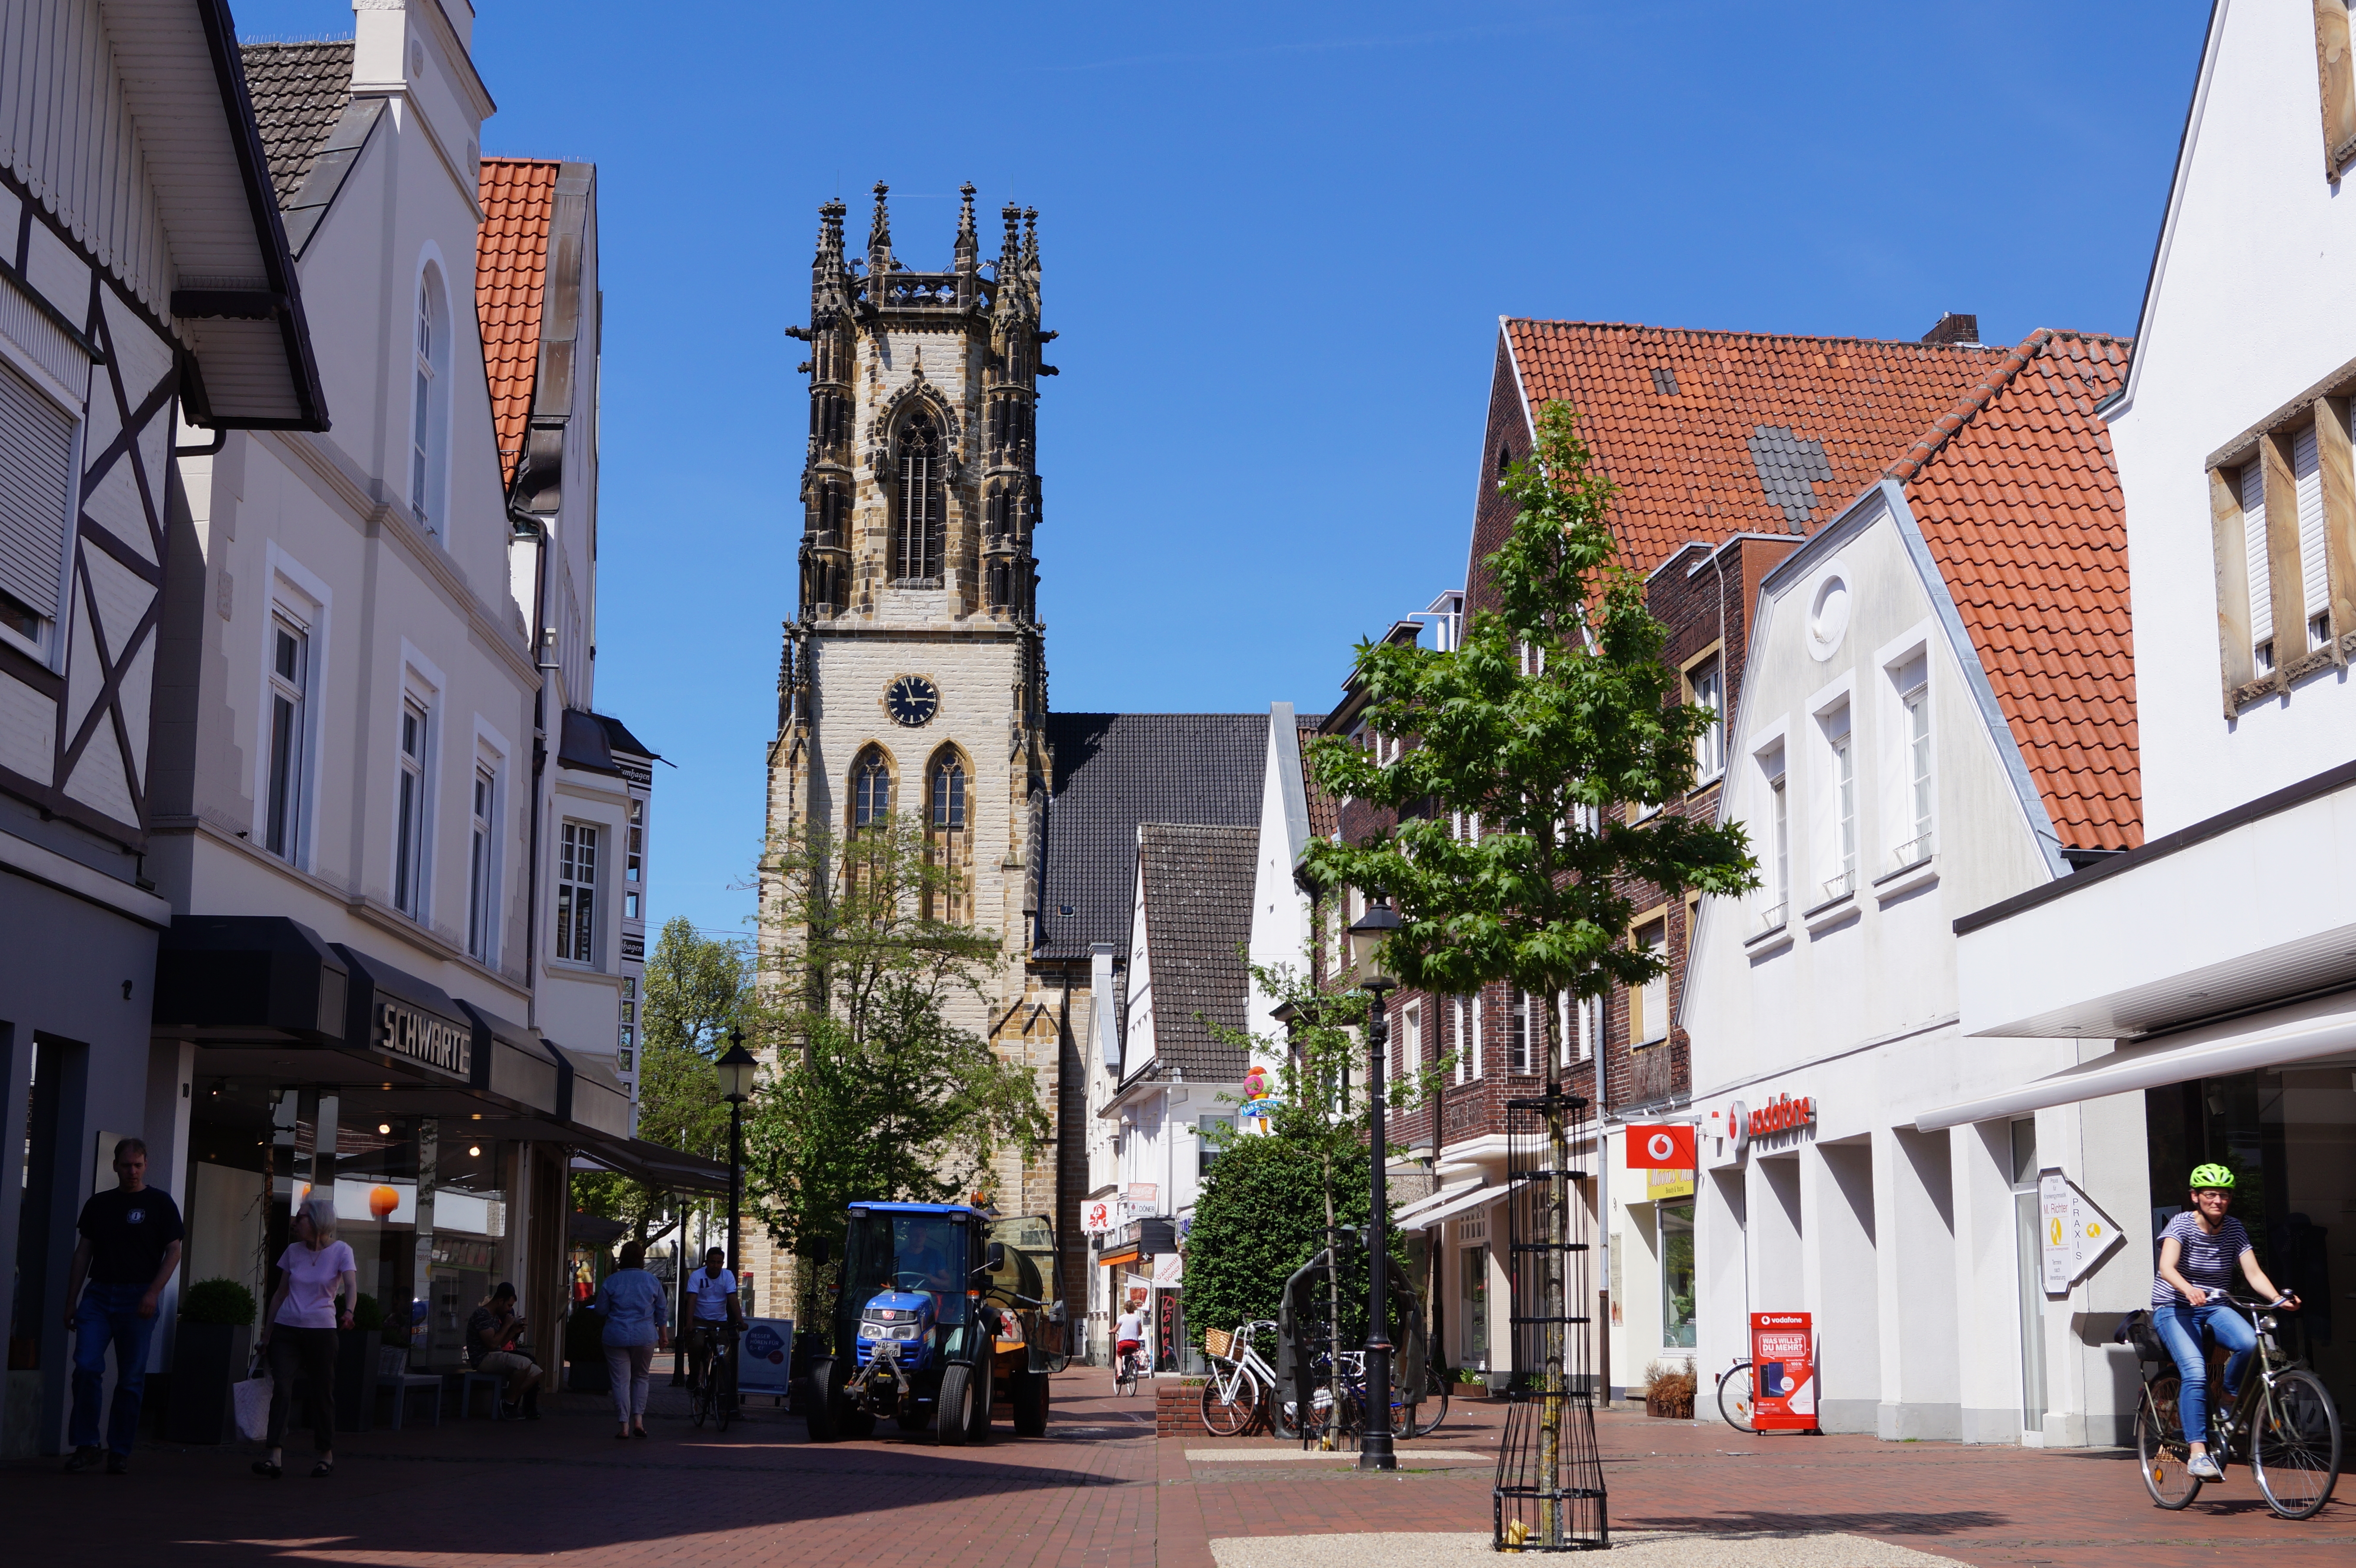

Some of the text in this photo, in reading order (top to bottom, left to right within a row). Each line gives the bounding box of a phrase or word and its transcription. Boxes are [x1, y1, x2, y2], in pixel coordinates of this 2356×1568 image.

[383, 1003, 470, 1074] SCHWARTE
[183, 1083, 189, 1098] 10
[1243, 1104, 1254, 1114] Eis
[1748, 1093, 1810, 1136] vodafone
[1613, 1197, 1617, 1212] 9
[2044, 1202, 2068, 1214] M. Richter
[2072, 1198, 2082, 1260] PRAXIS
[1156, 1257, 1178, 1280] Özdemir
[1163, 1265, 1180, 1282] Döner
[1160, 1296, 1176, 1358] Döner
